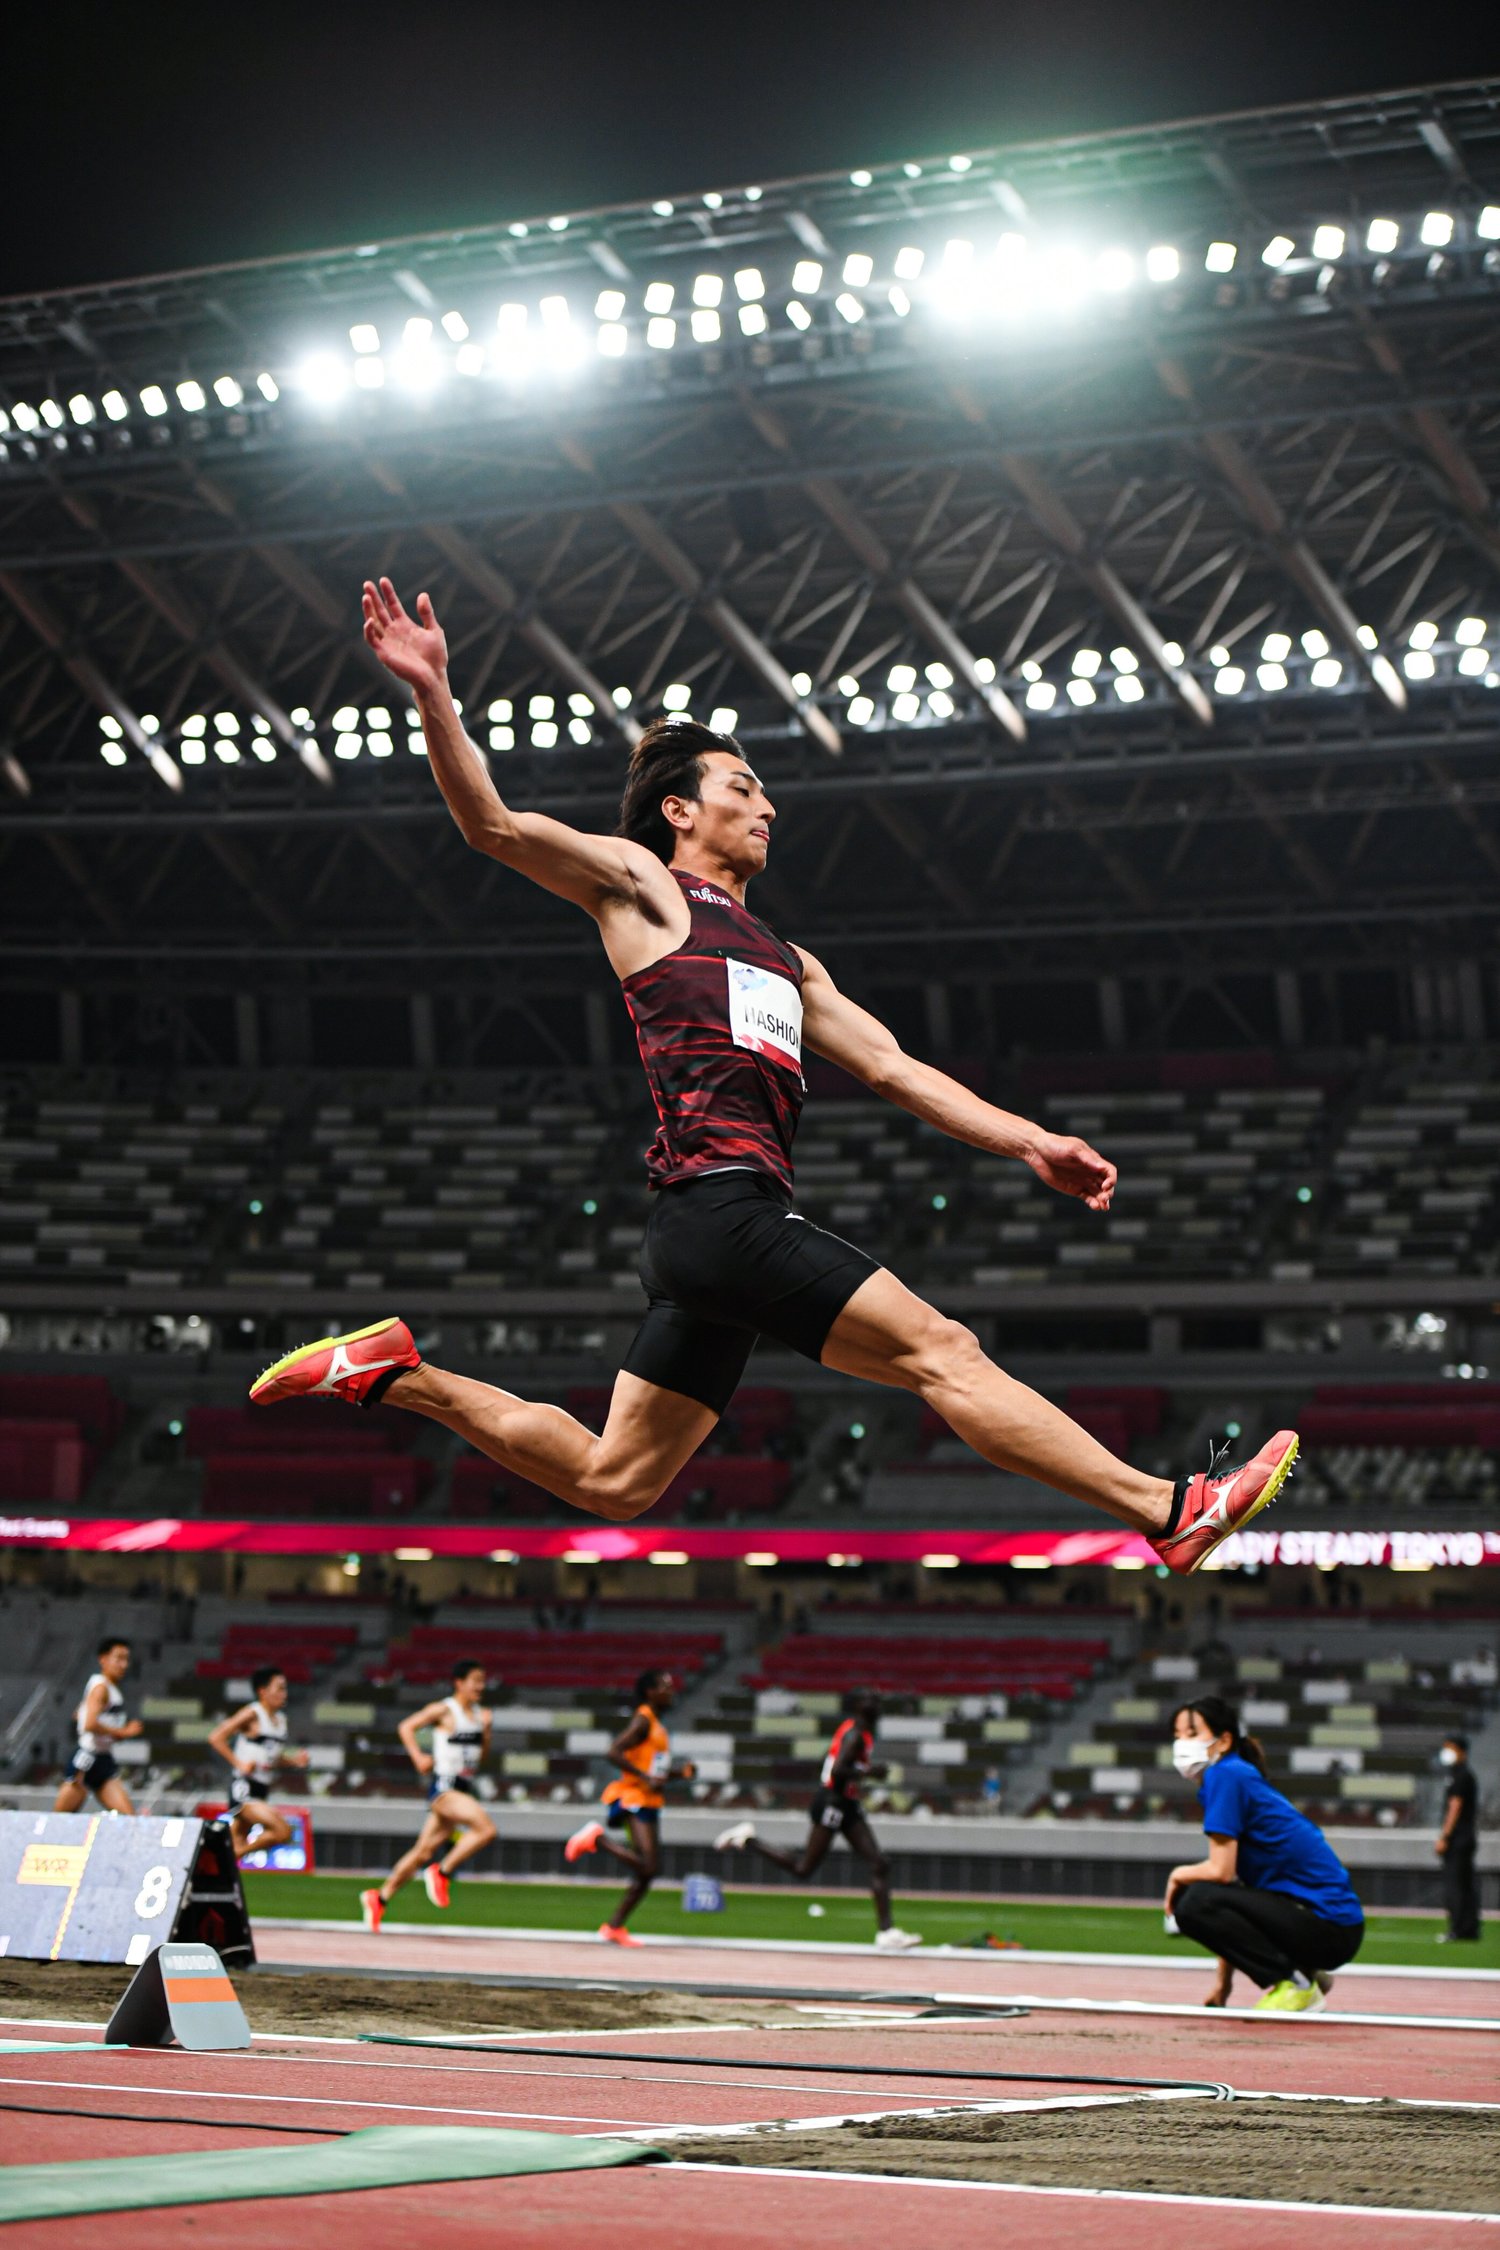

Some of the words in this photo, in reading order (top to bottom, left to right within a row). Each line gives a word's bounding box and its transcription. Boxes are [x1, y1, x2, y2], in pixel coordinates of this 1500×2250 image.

[689, 887, 732, 908] FUJITSU
[1279, 1531, 1390, 1566] STEADY
[1389, 1531, 1484, 1566] TOKYO
[134, 1866, 172, 1919] 8
